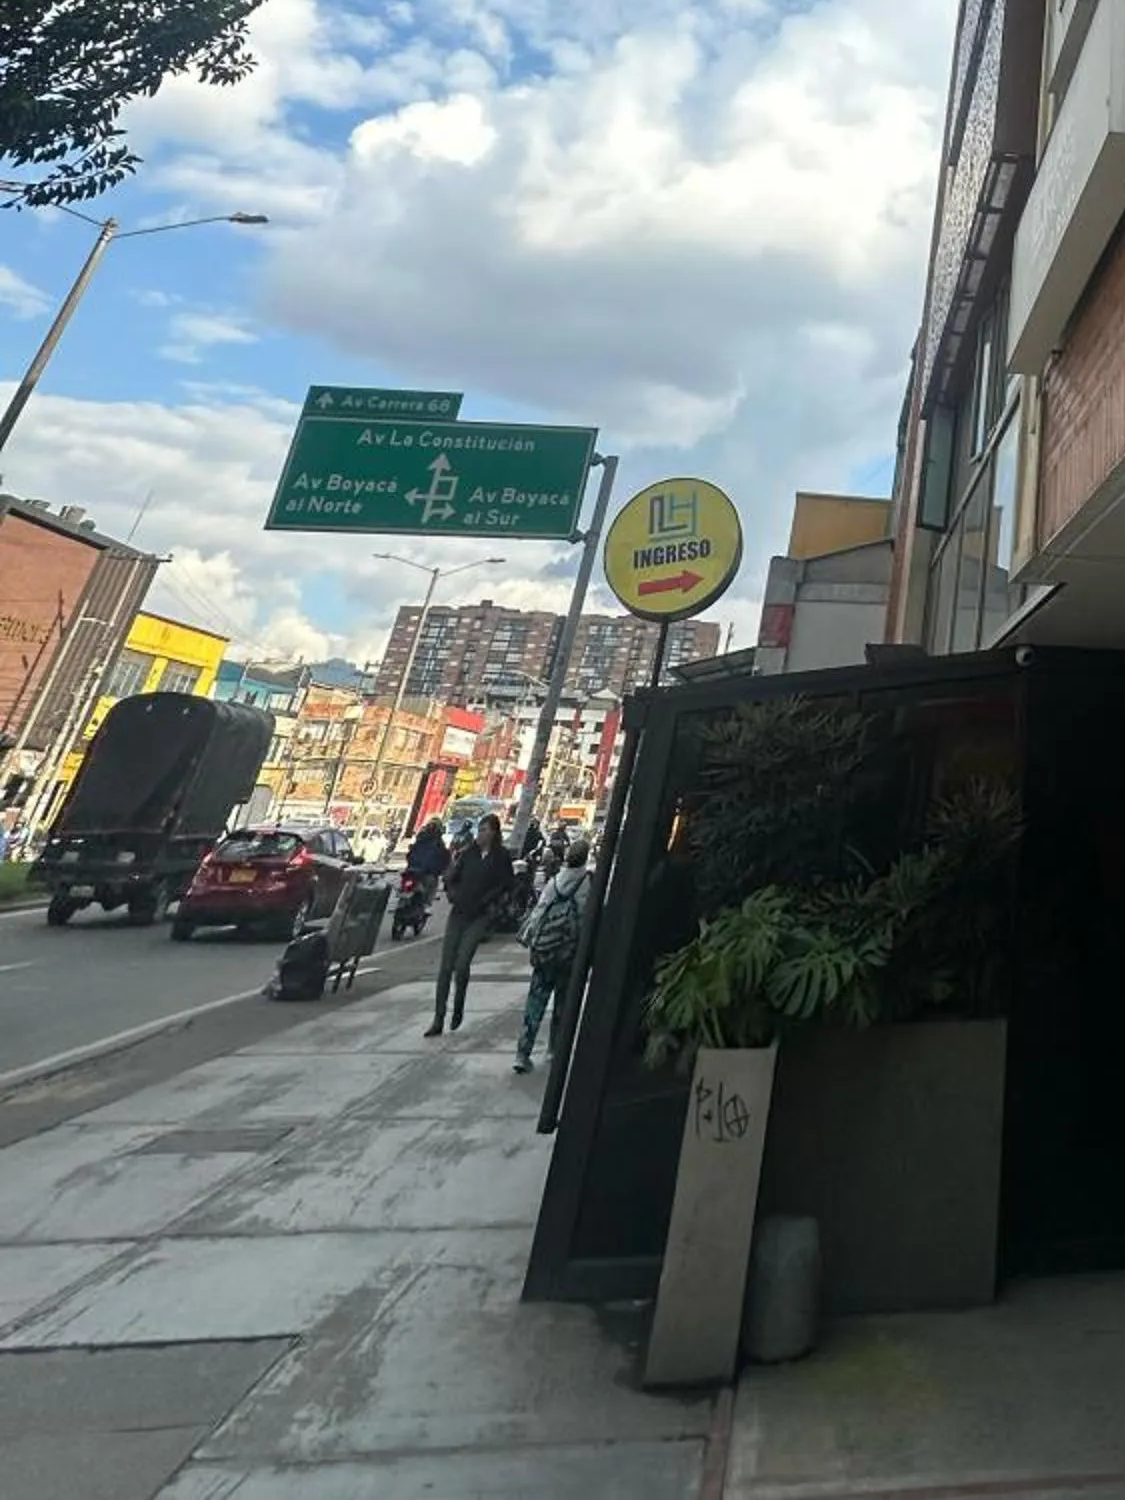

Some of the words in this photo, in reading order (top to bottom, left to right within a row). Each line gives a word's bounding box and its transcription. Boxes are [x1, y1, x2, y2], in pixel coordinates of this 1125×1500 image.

[340, 395, 363, 408] Av
[367, 396, 423, 412] Carrera
[357, 428, 385, 446] Av
[390, 429, 413, 447] La
[291, 472, 322, 489] Av
[327, 473, 398, 497] Boyacá
[468, 486, 497, 503] Av
[285, 497, 304, 512] al
[308, 496, 363, 514] Norte
[463, 510, 481, 525] al
[485, 508, 520, 526] Sur
[633, 538, 712, 570] INGRESO
